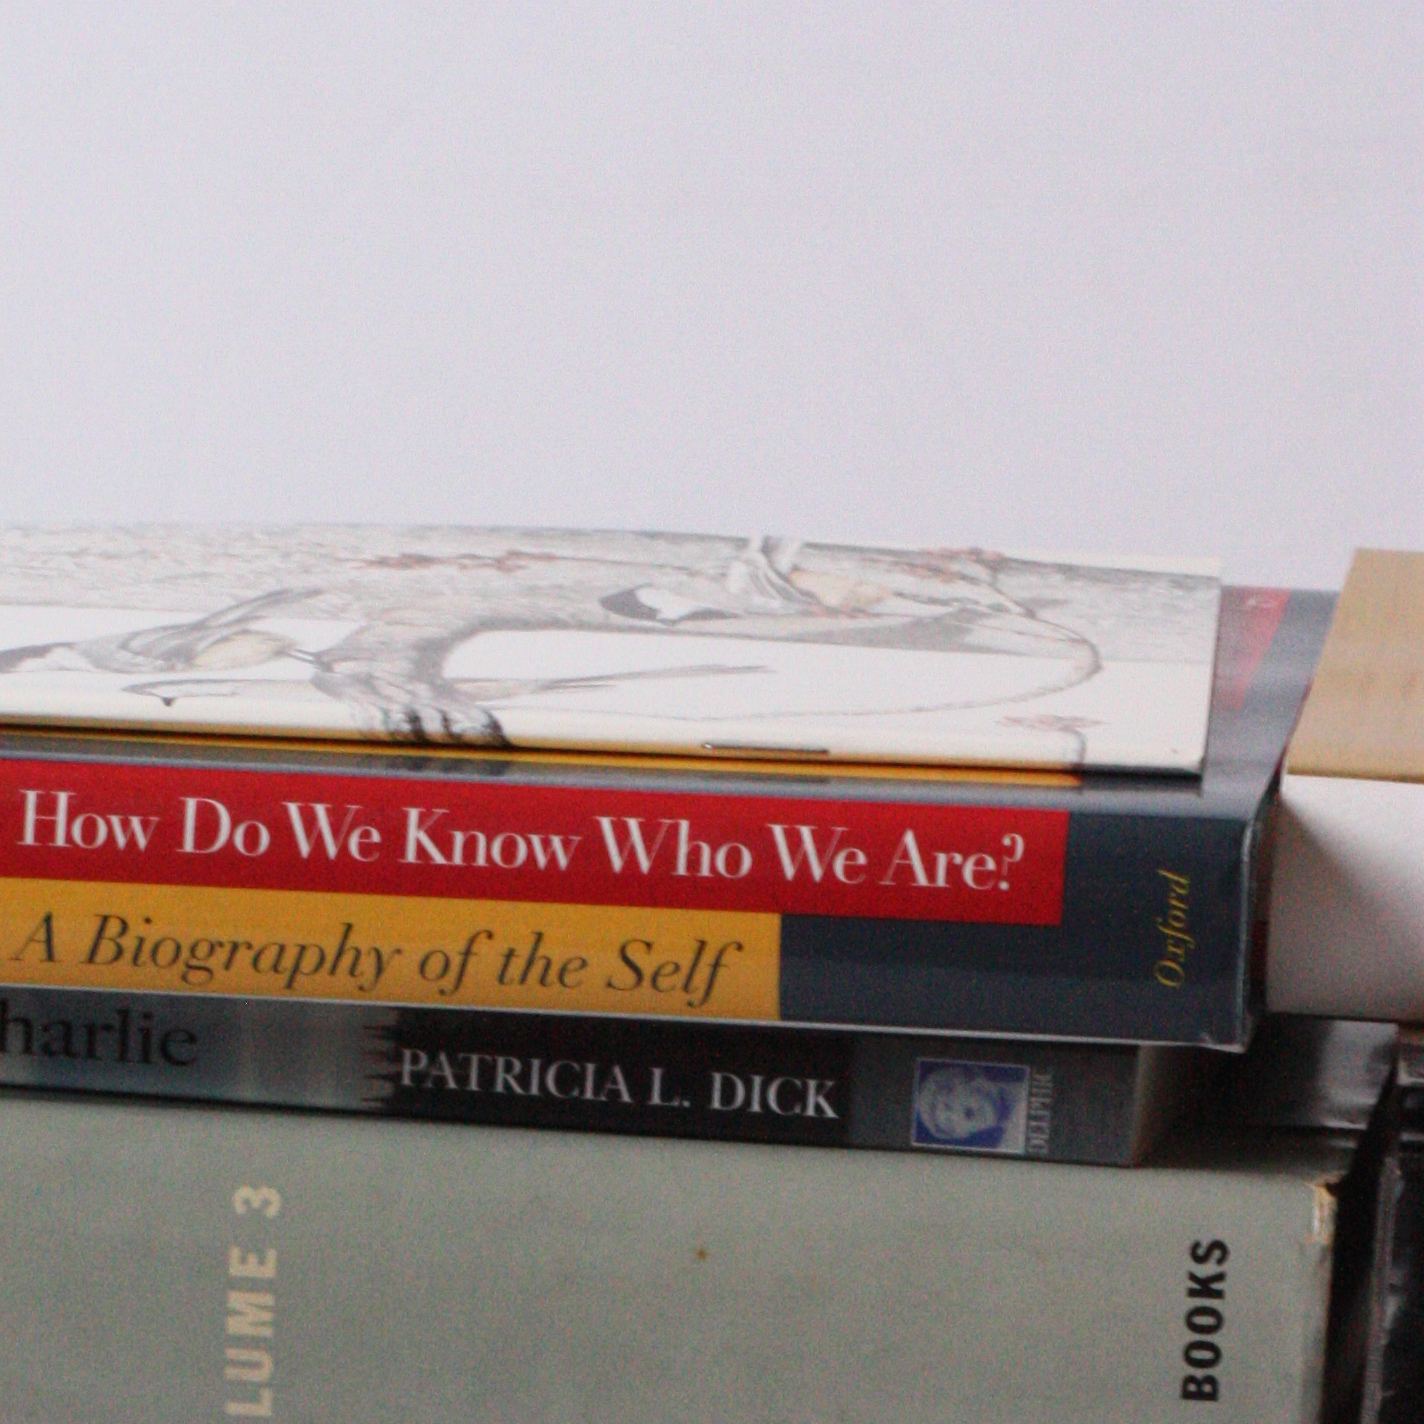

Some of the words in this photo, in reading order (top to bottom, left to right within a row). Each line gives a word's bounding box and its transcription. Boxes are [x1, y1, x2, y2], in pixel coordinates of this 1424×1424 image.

[16, 789, 160, 854] How
[176, 796, 271, 857] Do
[282, 800, 381, 862] We
[397, 806, 582, 872] Know
[593, 815, 753, 879] Who
[767, 823, 867, 884] We
[878, 829, 1025, 892] Are?
[8, 910, 64, 964] A
[78, 913, 403, 994] Biography
[418, 929, 493, 998] of
[495, 930, 589, 990] the
[605, 938, 744, 1009] Self
[1153, 868, 1195, 988] Oxford
[400, 1047, 635, 1103] PATRICIA
[648, 1066, 692, 1109] L.
[709, 1071, 840, 1120] DICK
[232, 1184, 283, 1220] 3
[1179, 1237, 1231, 1402] BOOKS
